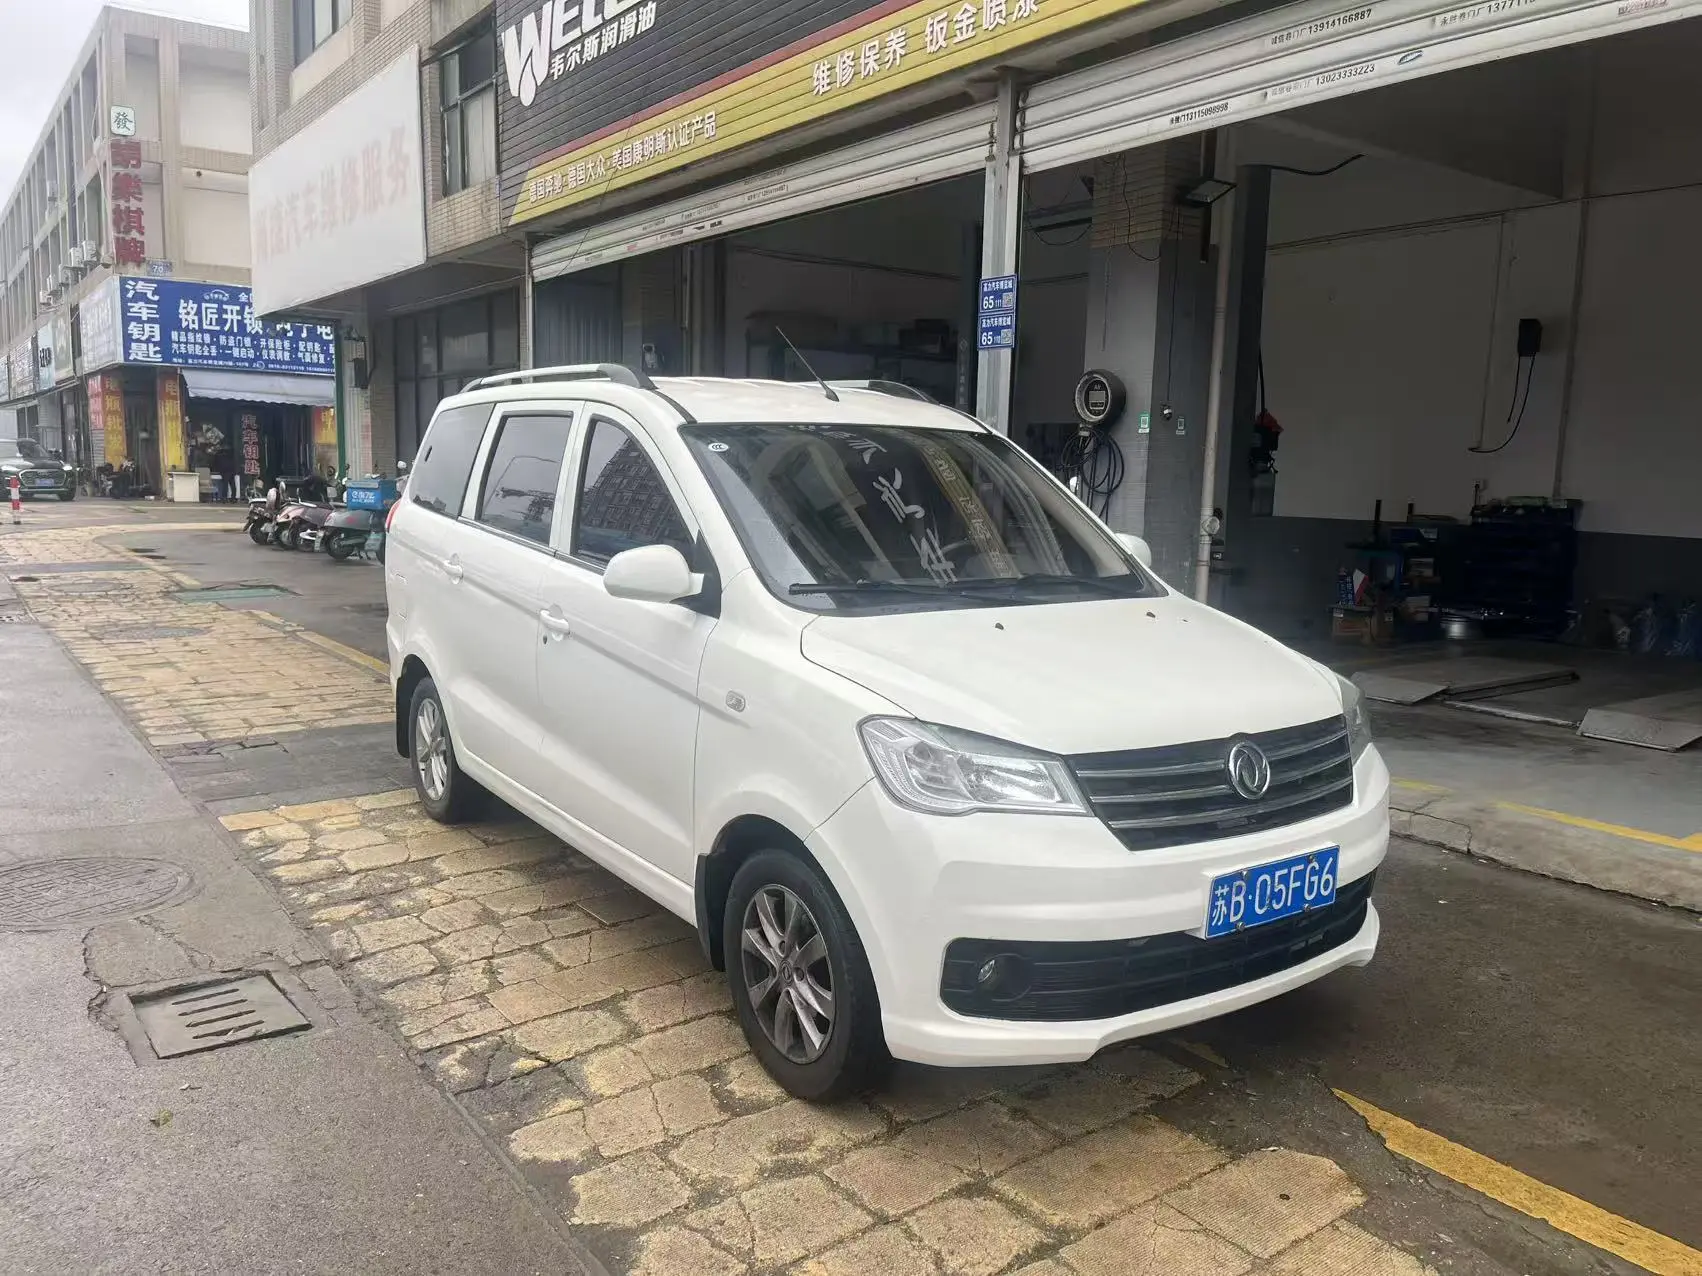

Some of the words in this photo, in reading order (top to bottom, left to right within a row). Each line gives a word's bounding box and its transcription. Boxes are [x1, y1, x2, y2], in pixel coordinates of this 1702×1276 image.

[551, 1, 657, 80] 韦尔斯润滑油
[812, 28, 908, 96] 维修保养
[1315, 63, 1375, 86] 13023333223
[114, 111, 134, 132] 發
[983, 295, 995, 309] 65
[125, 280, 163, 361] 汽车钥匙
[178, 299, 263, 336] 铭匠开锁
[981, 331, 993, 345] 65
